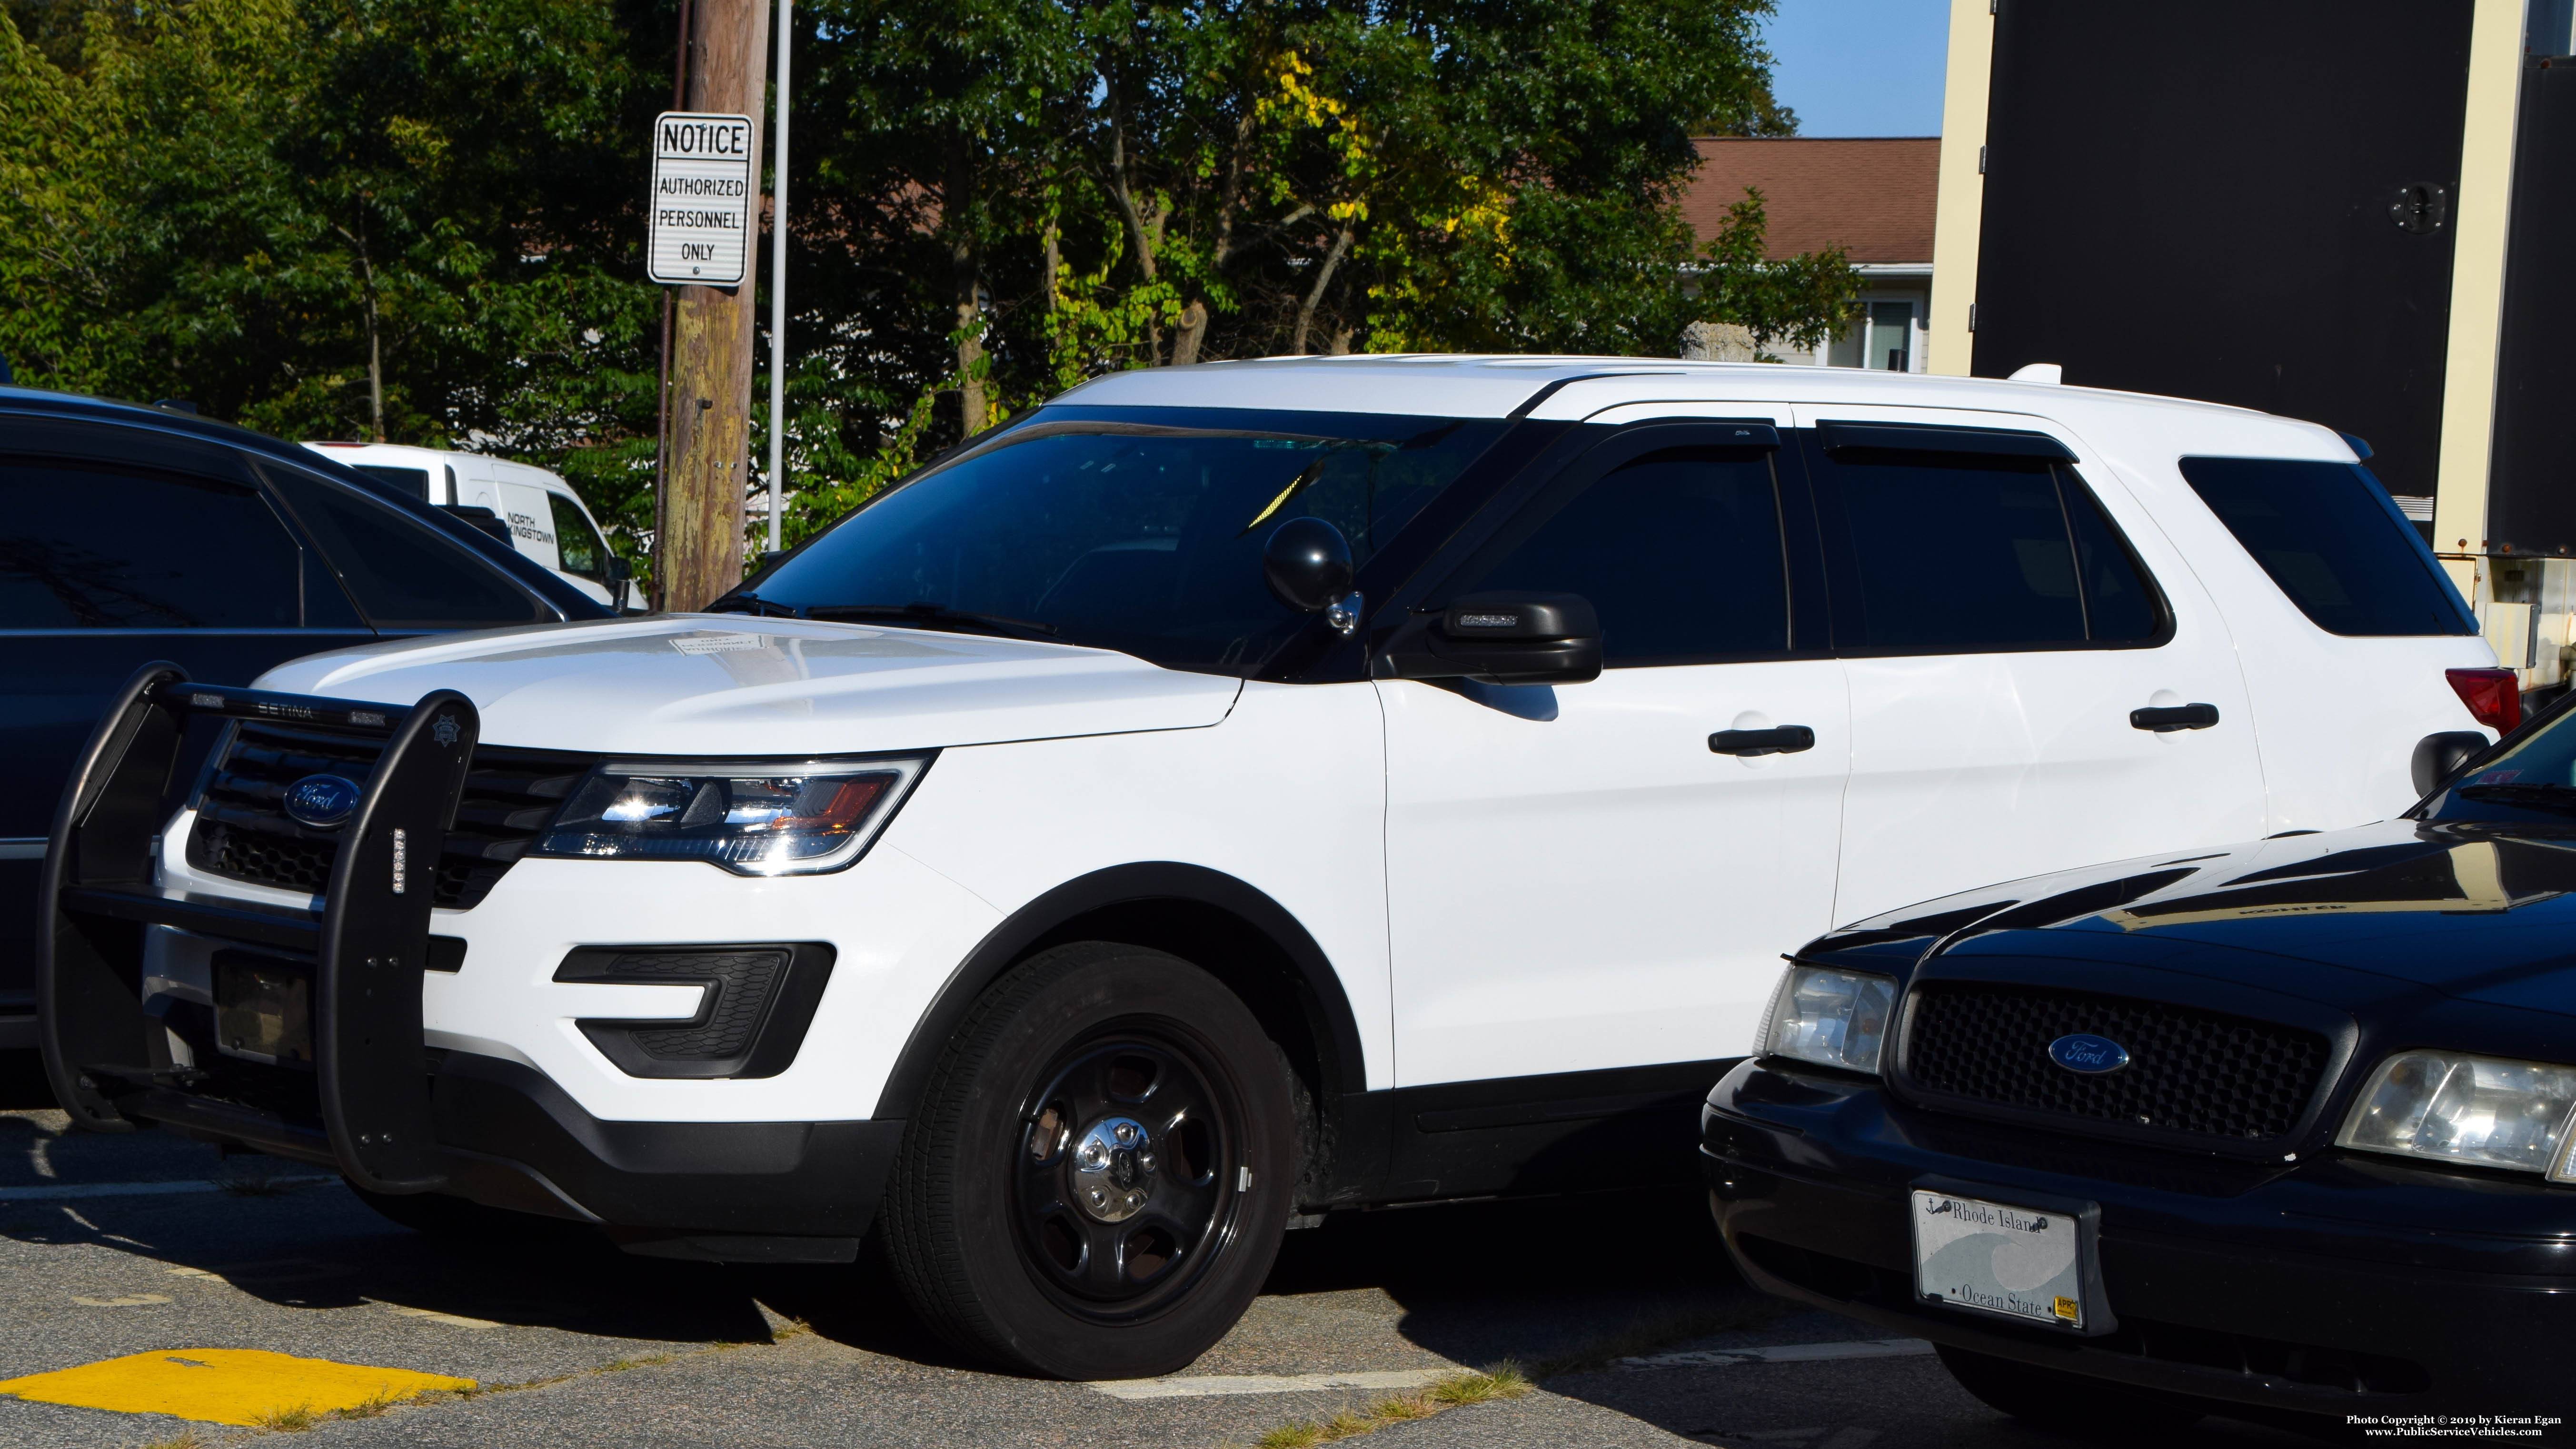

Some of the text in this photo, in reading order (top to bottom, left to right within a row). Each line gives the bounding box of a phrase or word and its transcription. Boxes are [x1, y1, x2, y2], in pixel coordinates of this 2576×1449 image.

[664, 124, 744, 154] NOTICE
[659, 178, 744, 196] AUTHORIZED
[659, 210, 740, 228] PERSONNEL
[682, 243, 715, 260] ONLY
[507, 511, 535, 528] NORTH
[259, 702, 313, 719] SETINA
[294, 784, 340, 811] Ford
[2065, 1041, 2107, 1064] Ford
[1952, 1201, 2041, 1234] Rhode Island
[1962, 1284, 2041, 1316] Ocean State
[2058, 1298, 2072, 1310] APR
